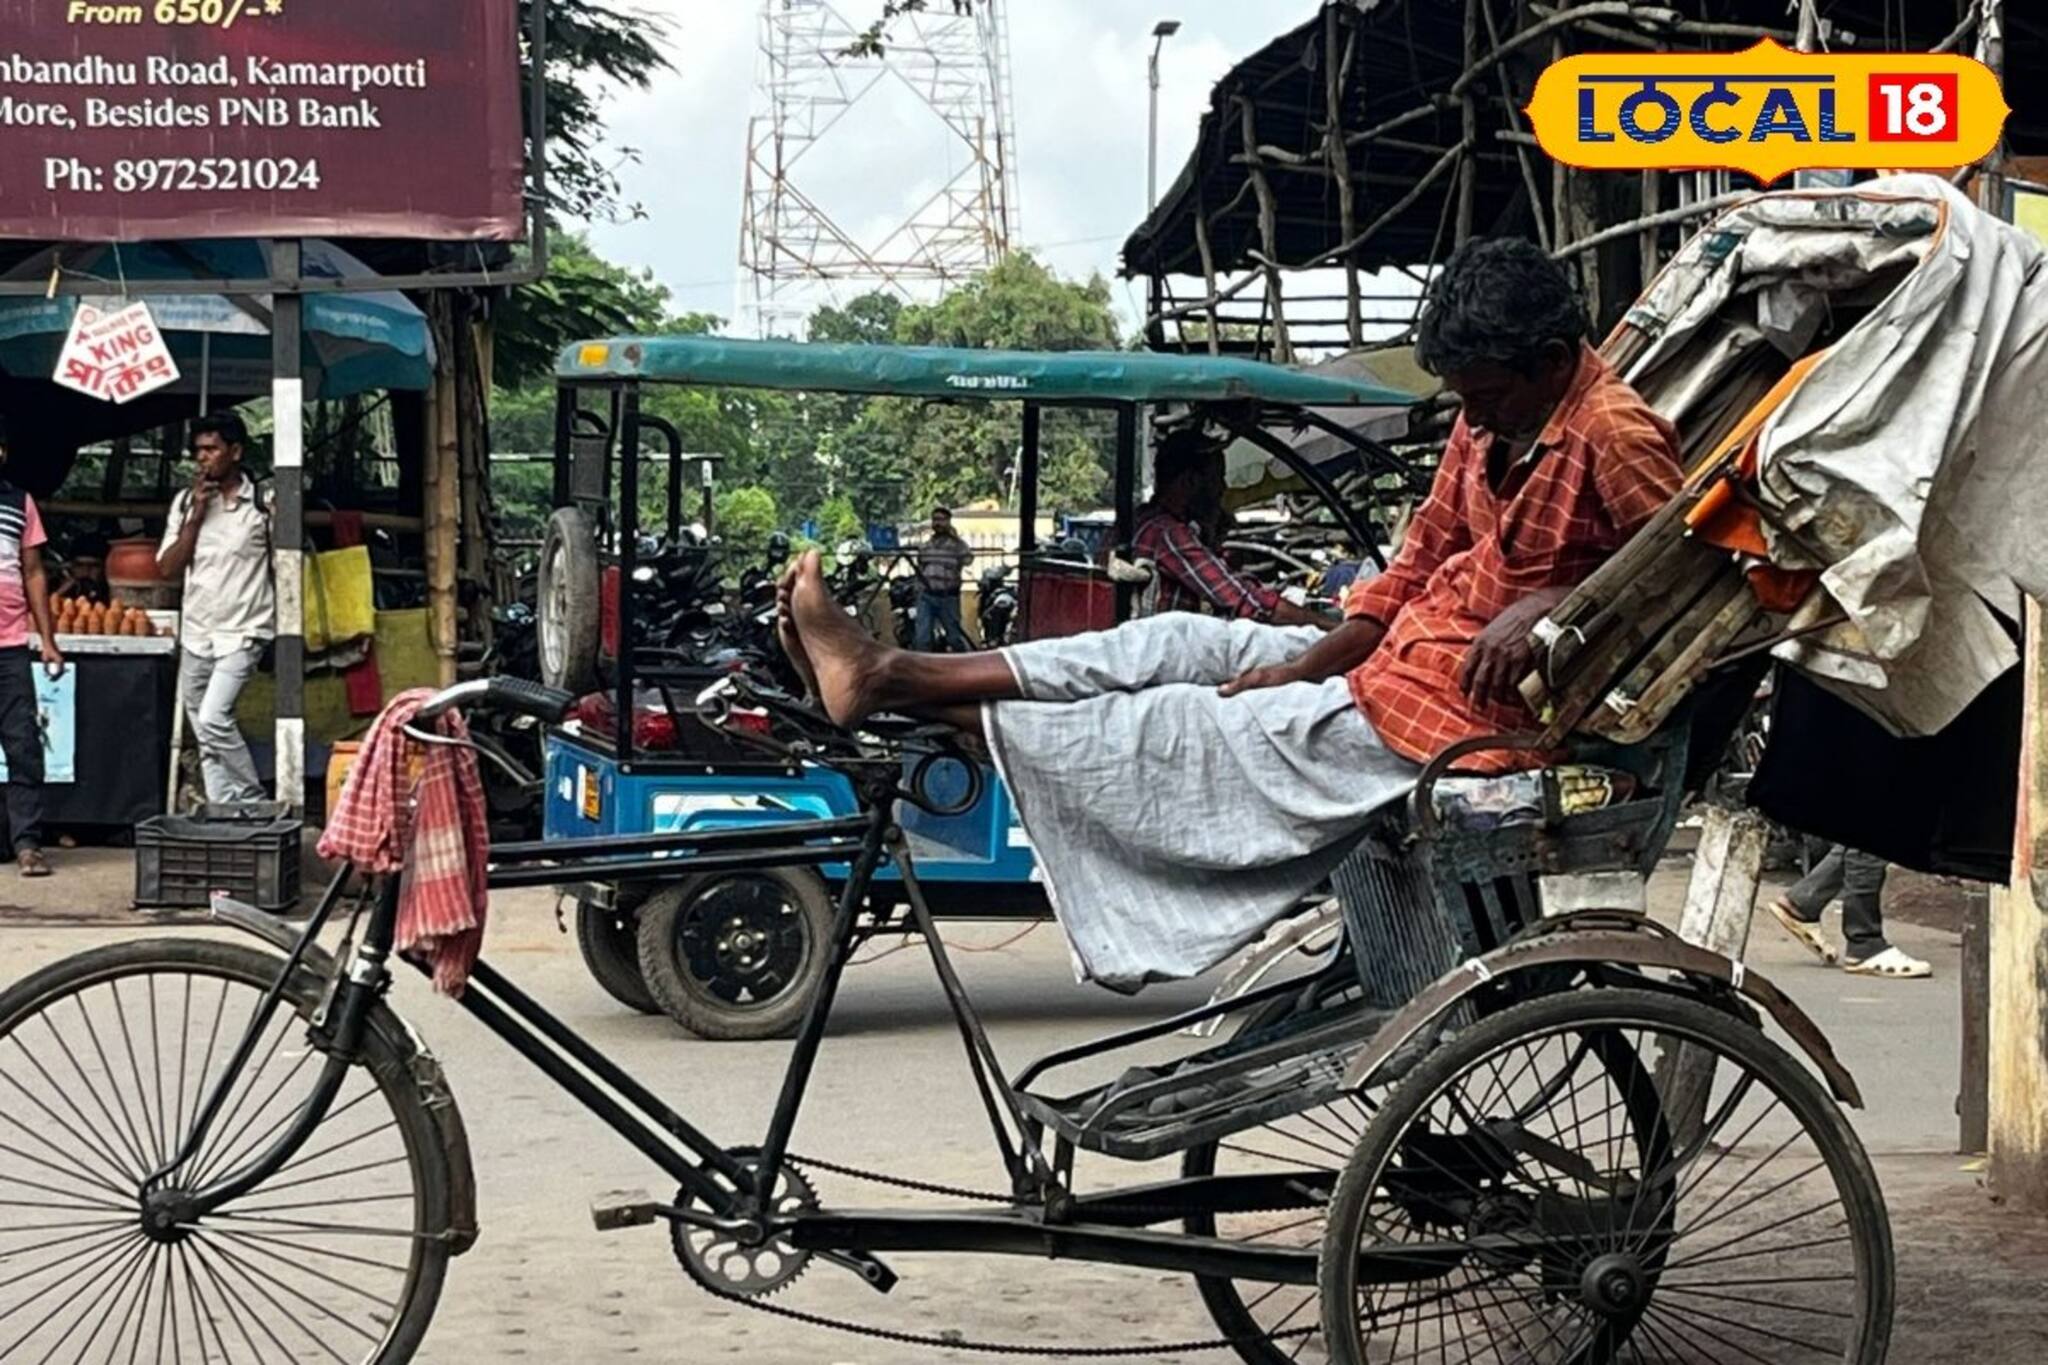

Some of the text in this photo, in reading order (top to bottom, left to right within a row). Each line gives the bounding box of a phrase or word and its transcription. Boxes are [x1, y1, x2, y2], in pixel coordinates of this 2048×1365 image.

[67, 1, 143, 24] From
[147, 55, 238, 87] Road,
[247, 55, 426, 92] Kamarpotti
[86, 97, 210, 127] Besides
[219, 97, 290, 126] PNB
[299, 99, 381, 128] Bank
[45, 157, 320, 192] Ph: 8972521024
